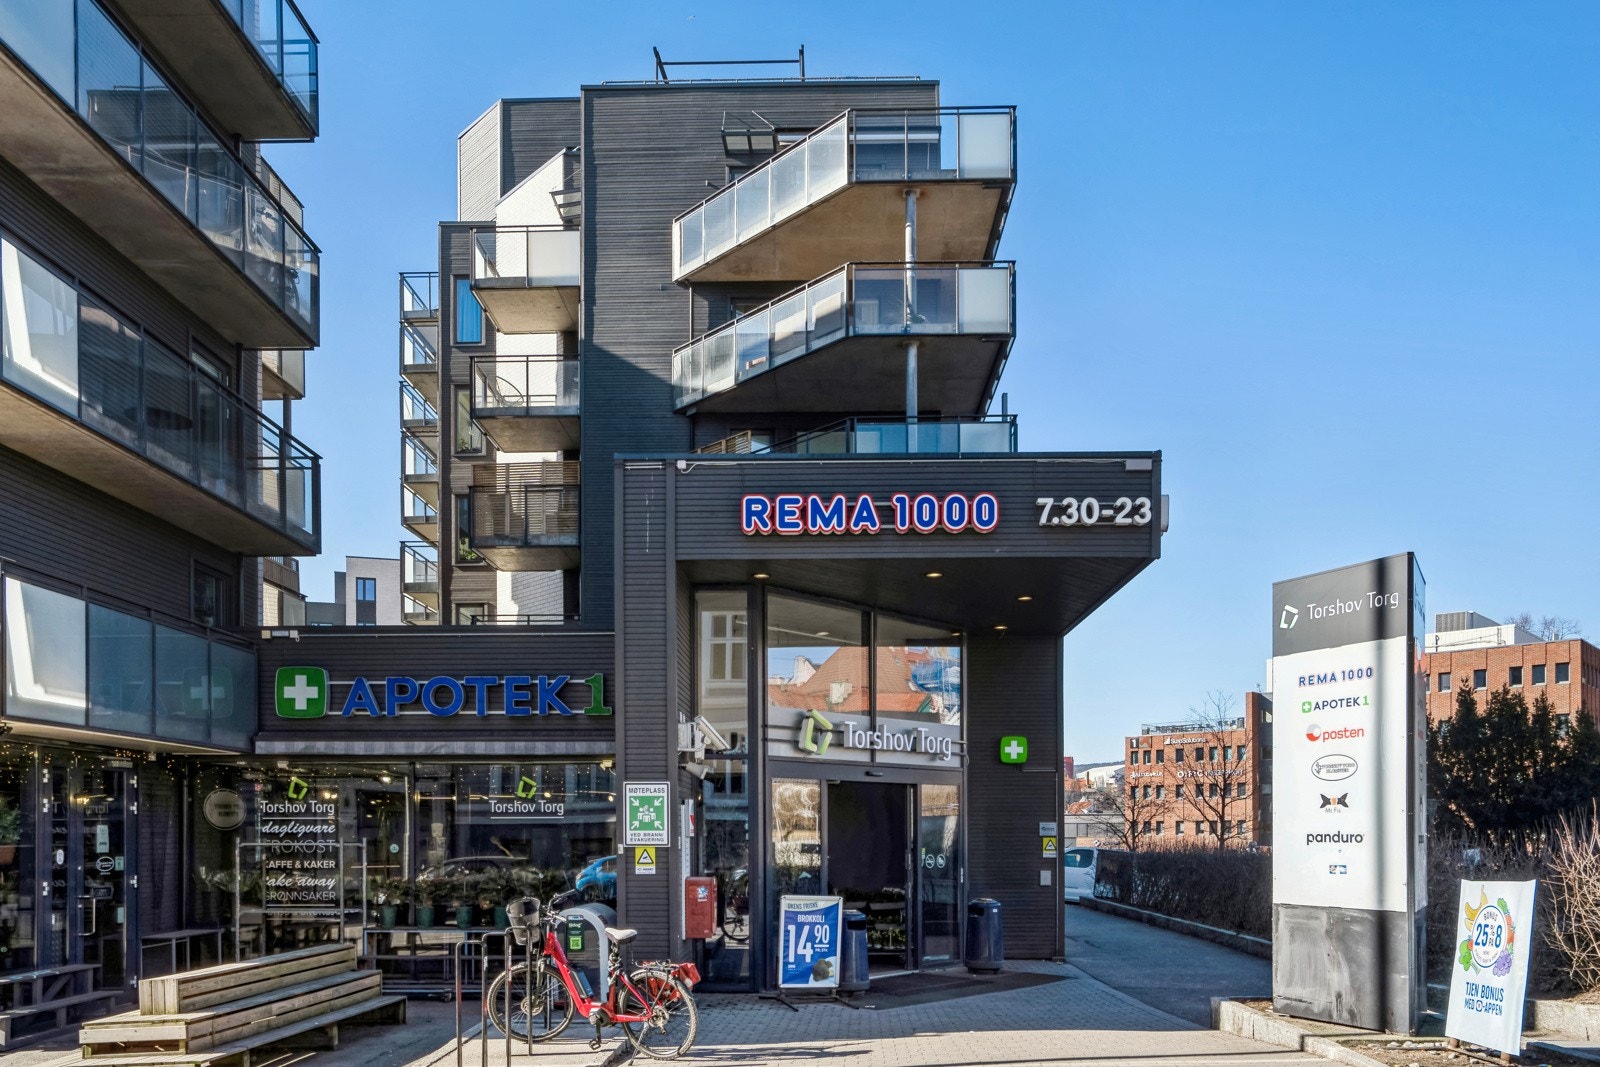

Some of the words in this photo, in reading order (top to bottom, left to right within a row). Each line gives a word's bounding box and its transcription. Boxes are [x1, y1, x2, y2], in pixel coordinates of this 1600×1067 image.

[741, 493, 881, 535] REMA
[891, 492, 999, 534] 1000
[1035, 496, 1152, 527] 7.30-23
[1307, 599, 1363, 620] Torshov
[1366, 591, 1399, 609] Torg
[1298, 672, 1337, 687] REMA
[1341, 667, 1373, 681] 1000
[341, 675, 574, 717] APOTEK
[583, 673, 613, 716] 1
[1313, 696, 1361, 711] APOTEK
[1362, 695, 1370, 706] 1
[844, 720, 916, 752] Torshov
[917, 727, 952, 761] Torg
[1322, 727, 1365, 742] posten
[261, 800, 307, 813] Torshov
[309, 800, 335, 816] Torg
[489, 800, 536, 813] Torshov
[538, 800, 564, 816] Torg
[262, 821, 336, 837] dagligvare
[1306, 831, 1363, 845] panduro
[294, 861, 302, 869] &
[303, 860, 336, 869] KAKER
[297, 876, 337, 890] away
[797, 914, 825, 923] BROKKOLI
[787, 924, 813, 963] 14
[814, 924, 830, 944] 90
[1474, 923, 1489, 947] 25
[1494, 924, 1502, 949] 8
[1465, 981, 1479, 997] TJEN
[1481, 984, 1504, 1003] BONUS
[1464, 998, 1474, 1010] MED
